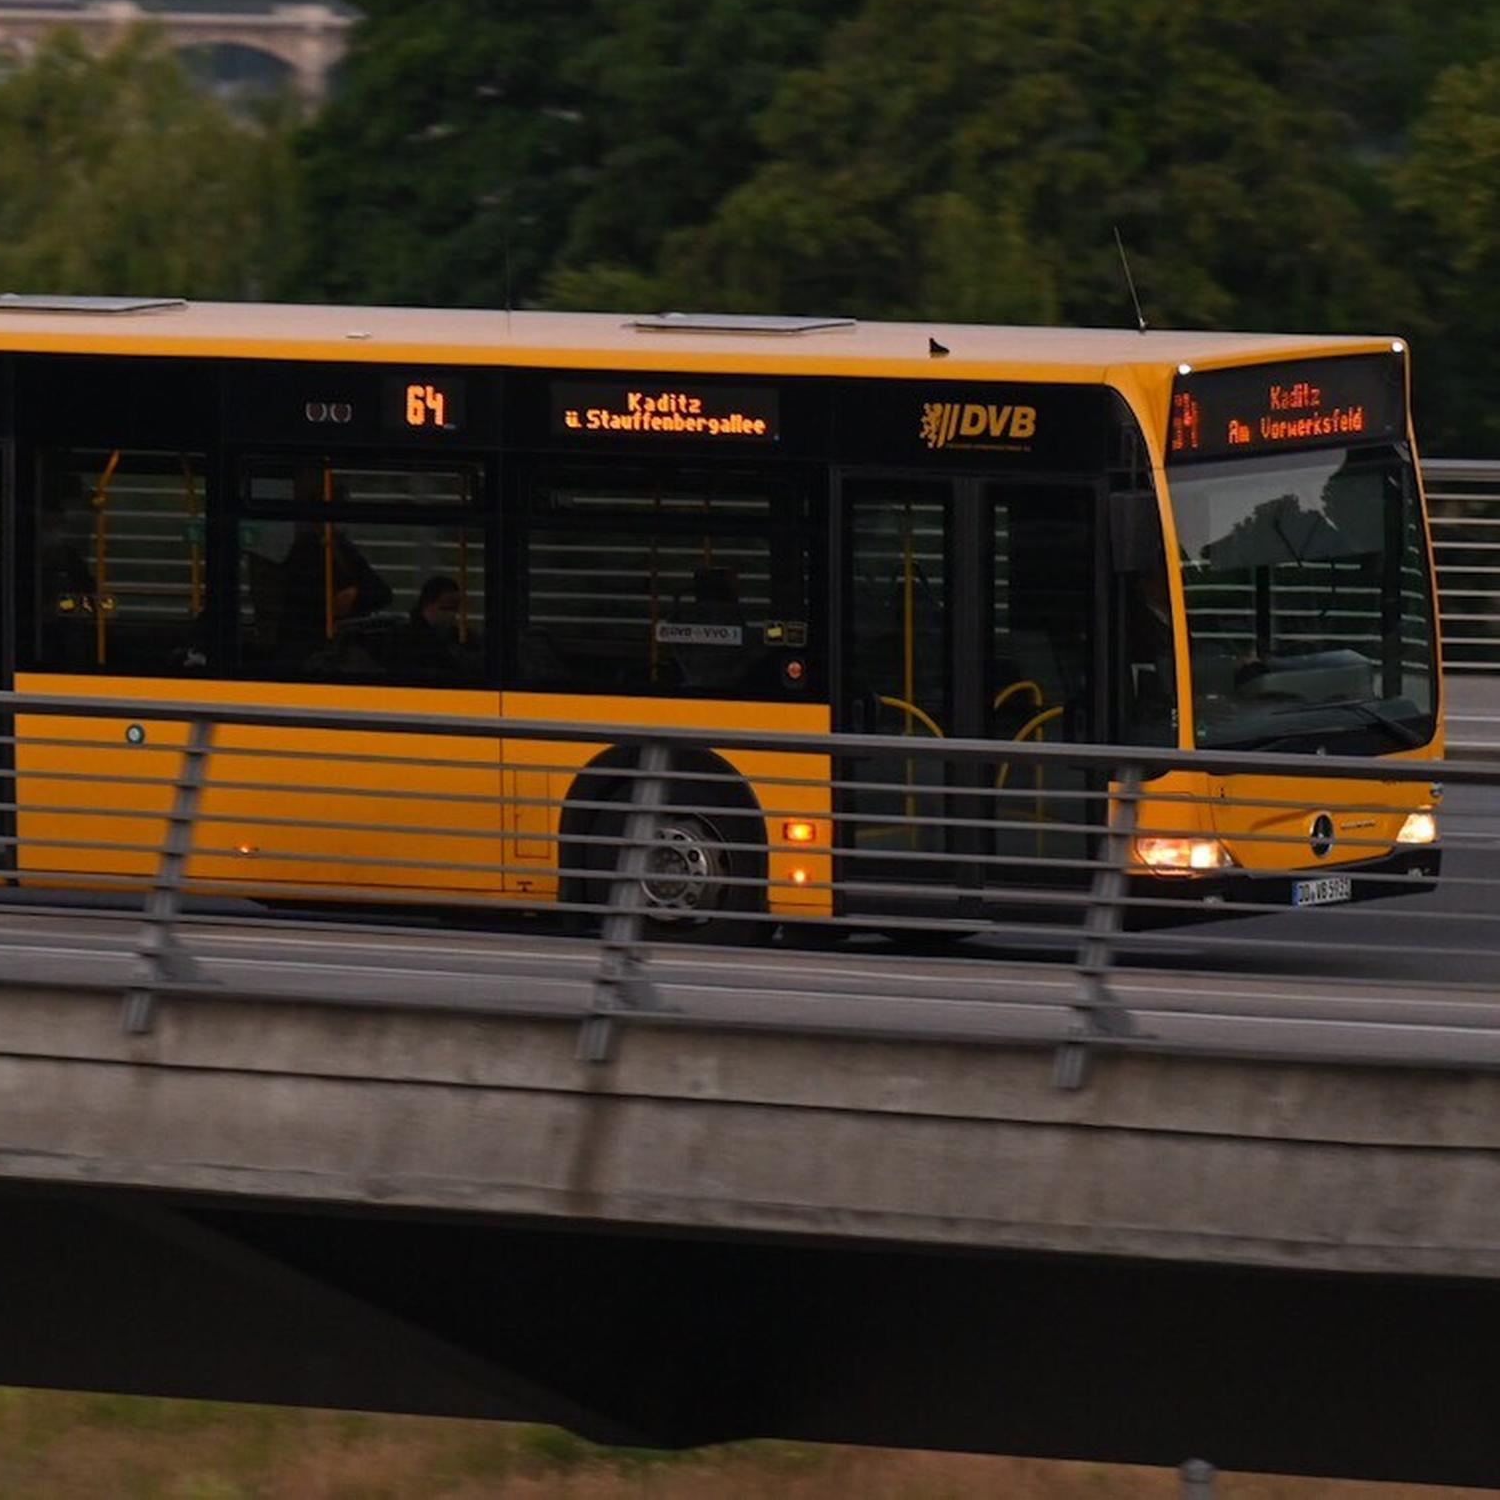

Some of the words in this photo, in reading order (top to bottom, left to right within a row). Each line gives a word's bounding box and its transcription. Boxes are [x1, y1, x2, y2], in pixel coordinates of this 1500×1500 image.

[406, 385, 444, 426] 64
[627, 393, 702, 413] Kaditz
[1270, 383, 1320, 410] Kaditz
[586, 409, 766, 435] Stauffenbergallee
[959, 404, 1036, 438] DVB
[1228, 419, 1251, 444] Am
[1261, 406, 1365, 439] Vorwerksfeld
